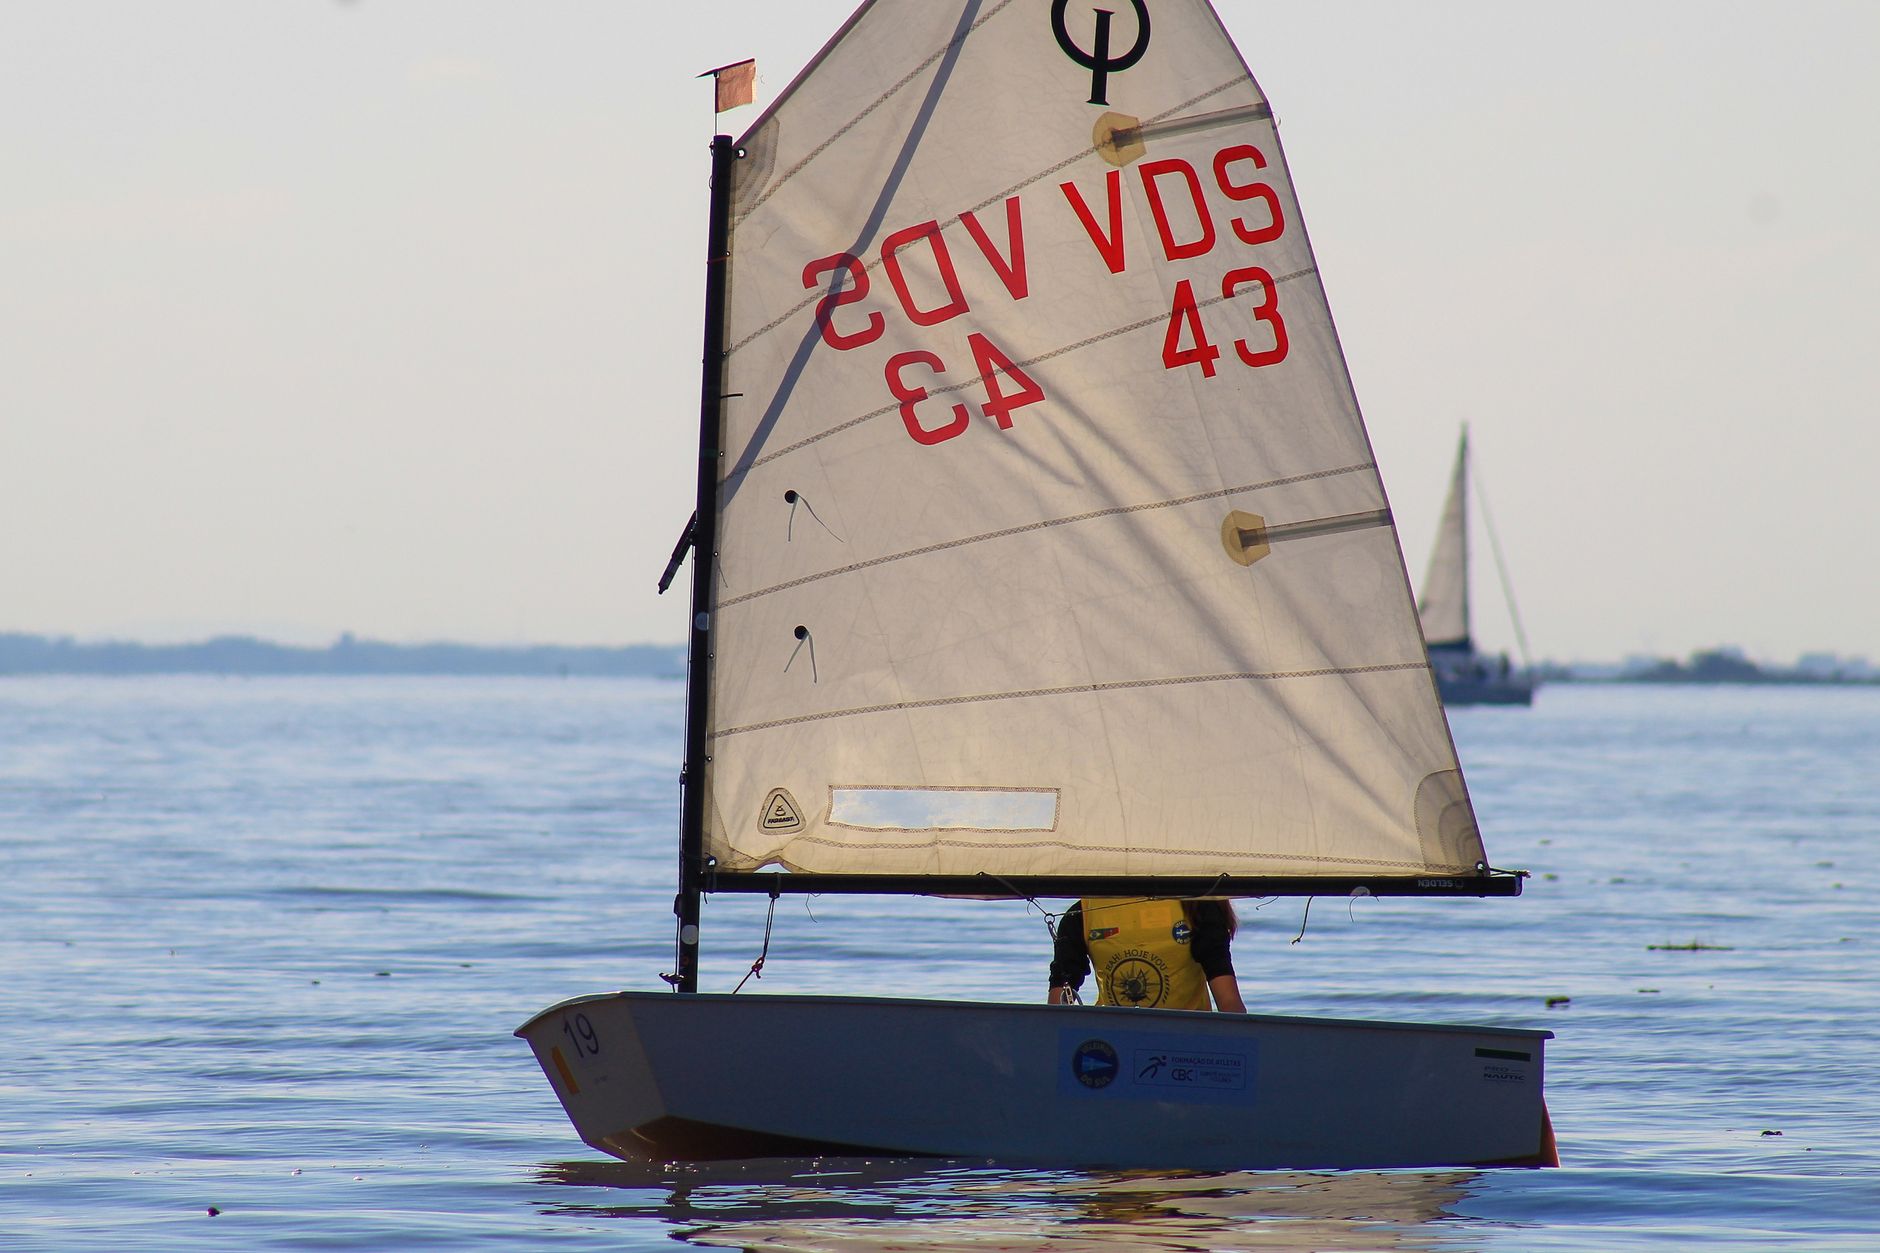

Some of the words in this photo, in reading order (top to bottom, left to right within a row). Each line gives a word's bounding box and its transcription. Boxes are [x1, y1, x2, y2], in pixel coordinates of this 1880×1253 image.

[1059, 143, 1285, 274] VDS
[1160, 265, 1290, 378] 43
[1124, 949, 1148, 959] HOJE
[1150, 954, 1167, 972] VOU
[563, 1012, 599, 1058] 19
[1171, 1068, 1194, 1081] CBC
